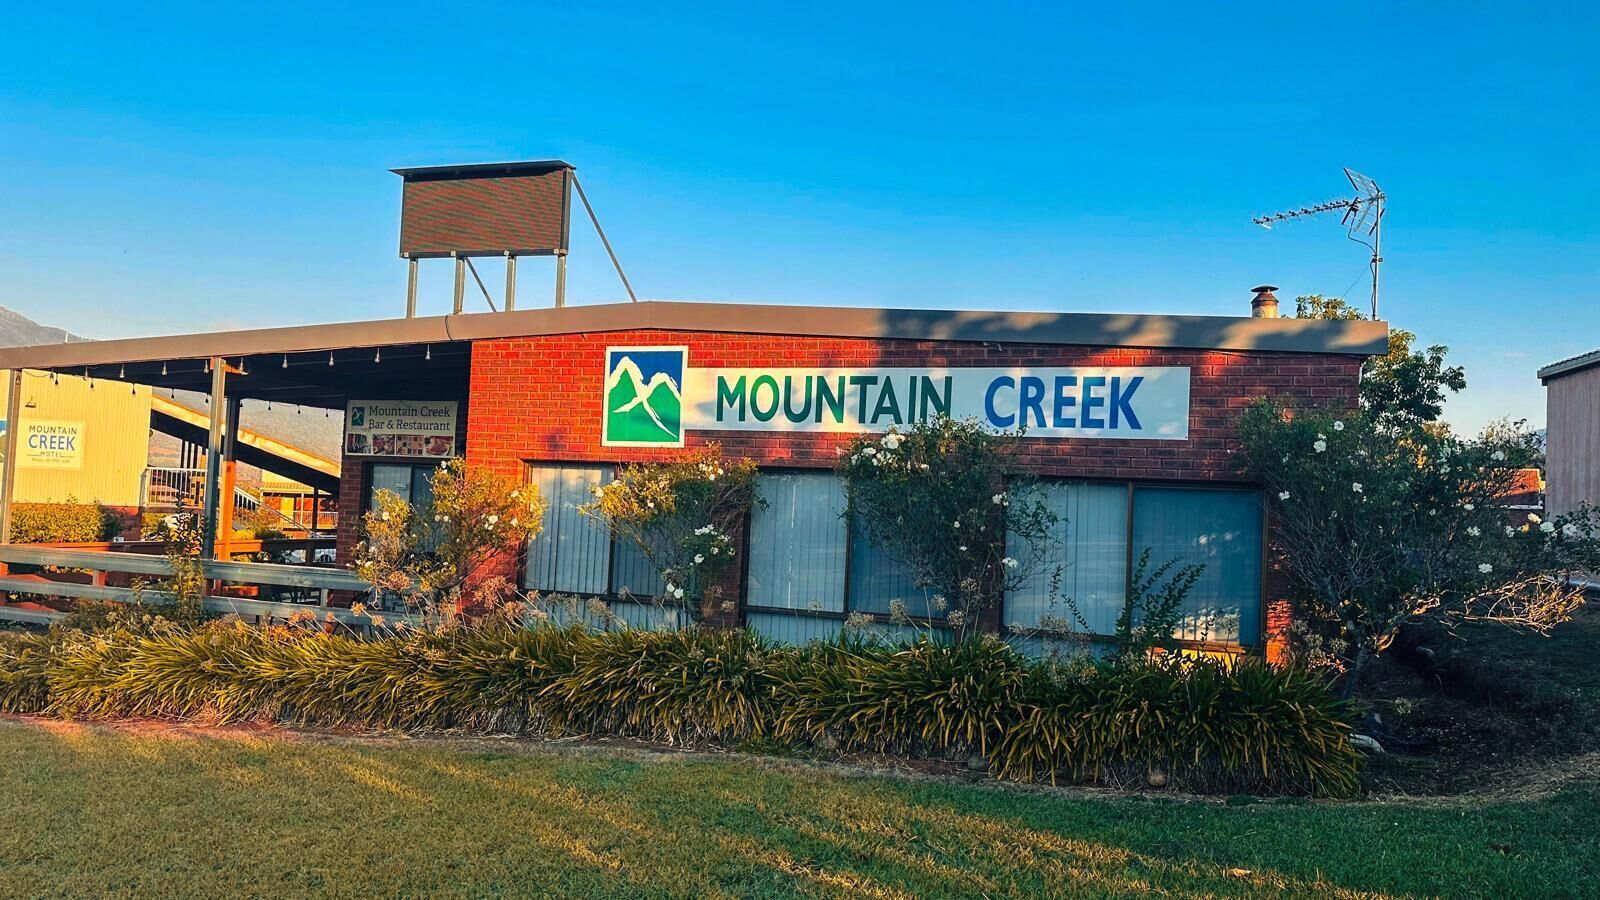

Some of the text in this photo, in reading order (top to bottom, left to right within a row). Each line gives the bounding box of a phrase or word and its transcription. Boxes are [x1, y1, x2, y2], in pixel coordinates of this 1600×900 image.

[716, 375, 1145, 430] MOUNTAIN CREEK
[369, 406, 450, 417] Mountain Creek
[29, 425, 77, 434] MOUNTAIN
[368, 419, 450, 431] Bar & Restaurant
[28, 434, 75, 451] CREEK
